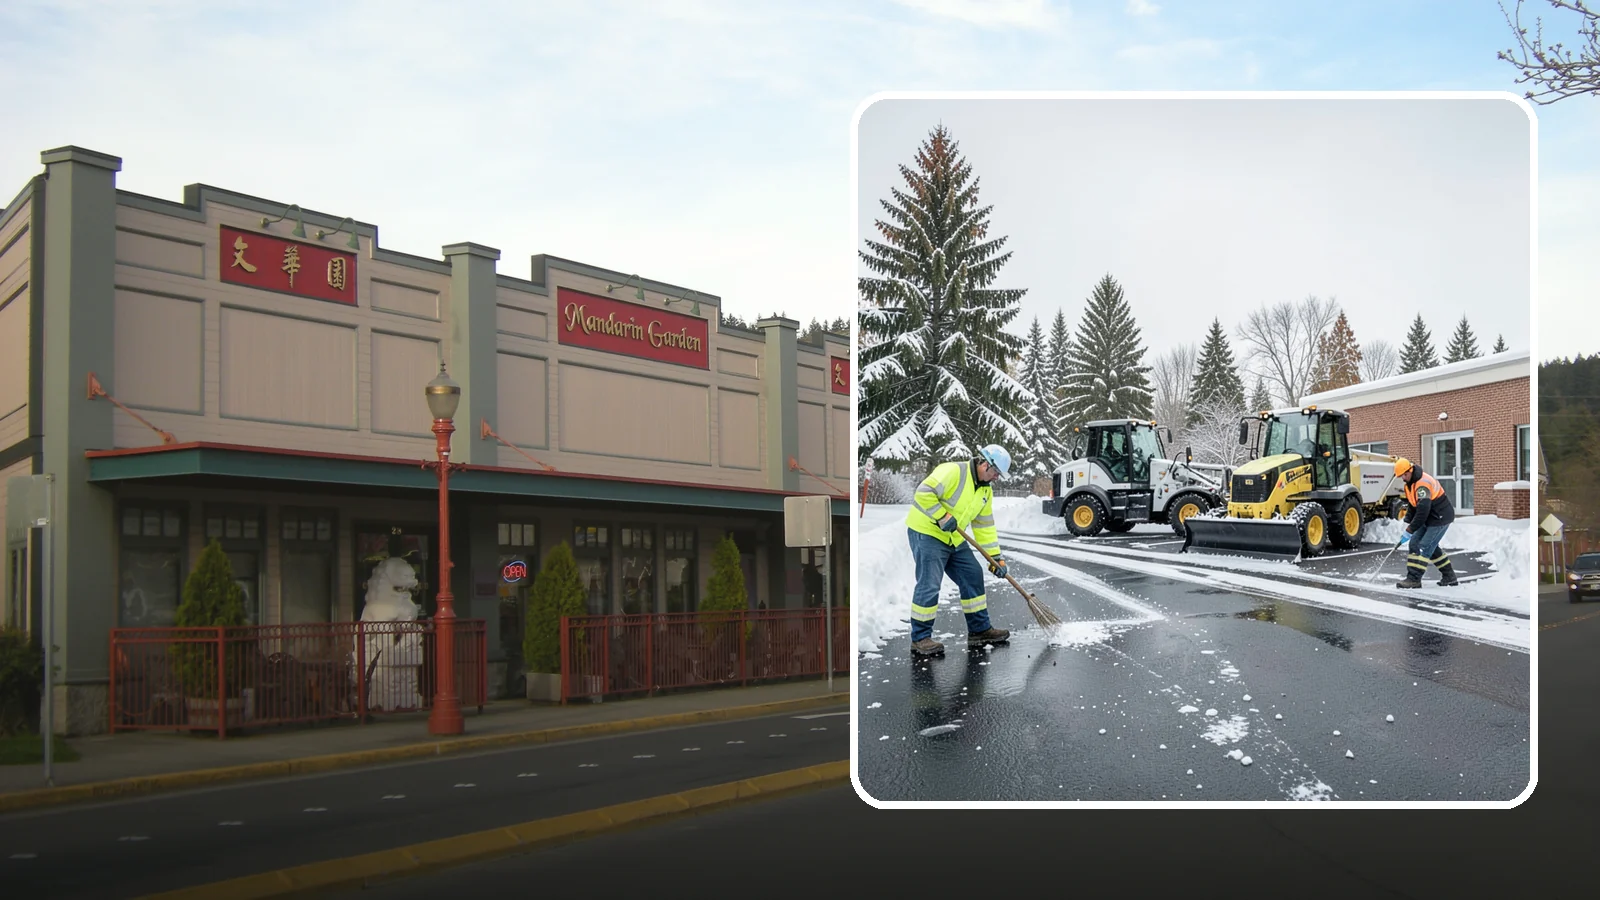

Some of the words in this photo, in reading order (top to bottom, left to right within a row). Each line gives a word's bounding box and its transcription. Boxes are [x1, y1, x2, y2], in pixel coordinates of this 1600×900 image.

[231, 236, 346, 290] 文華園
[564, 302, 644, 341] Mandarin
[648, 320, 701, 352] Garden
[503, 565, 527, 578] OPEN
